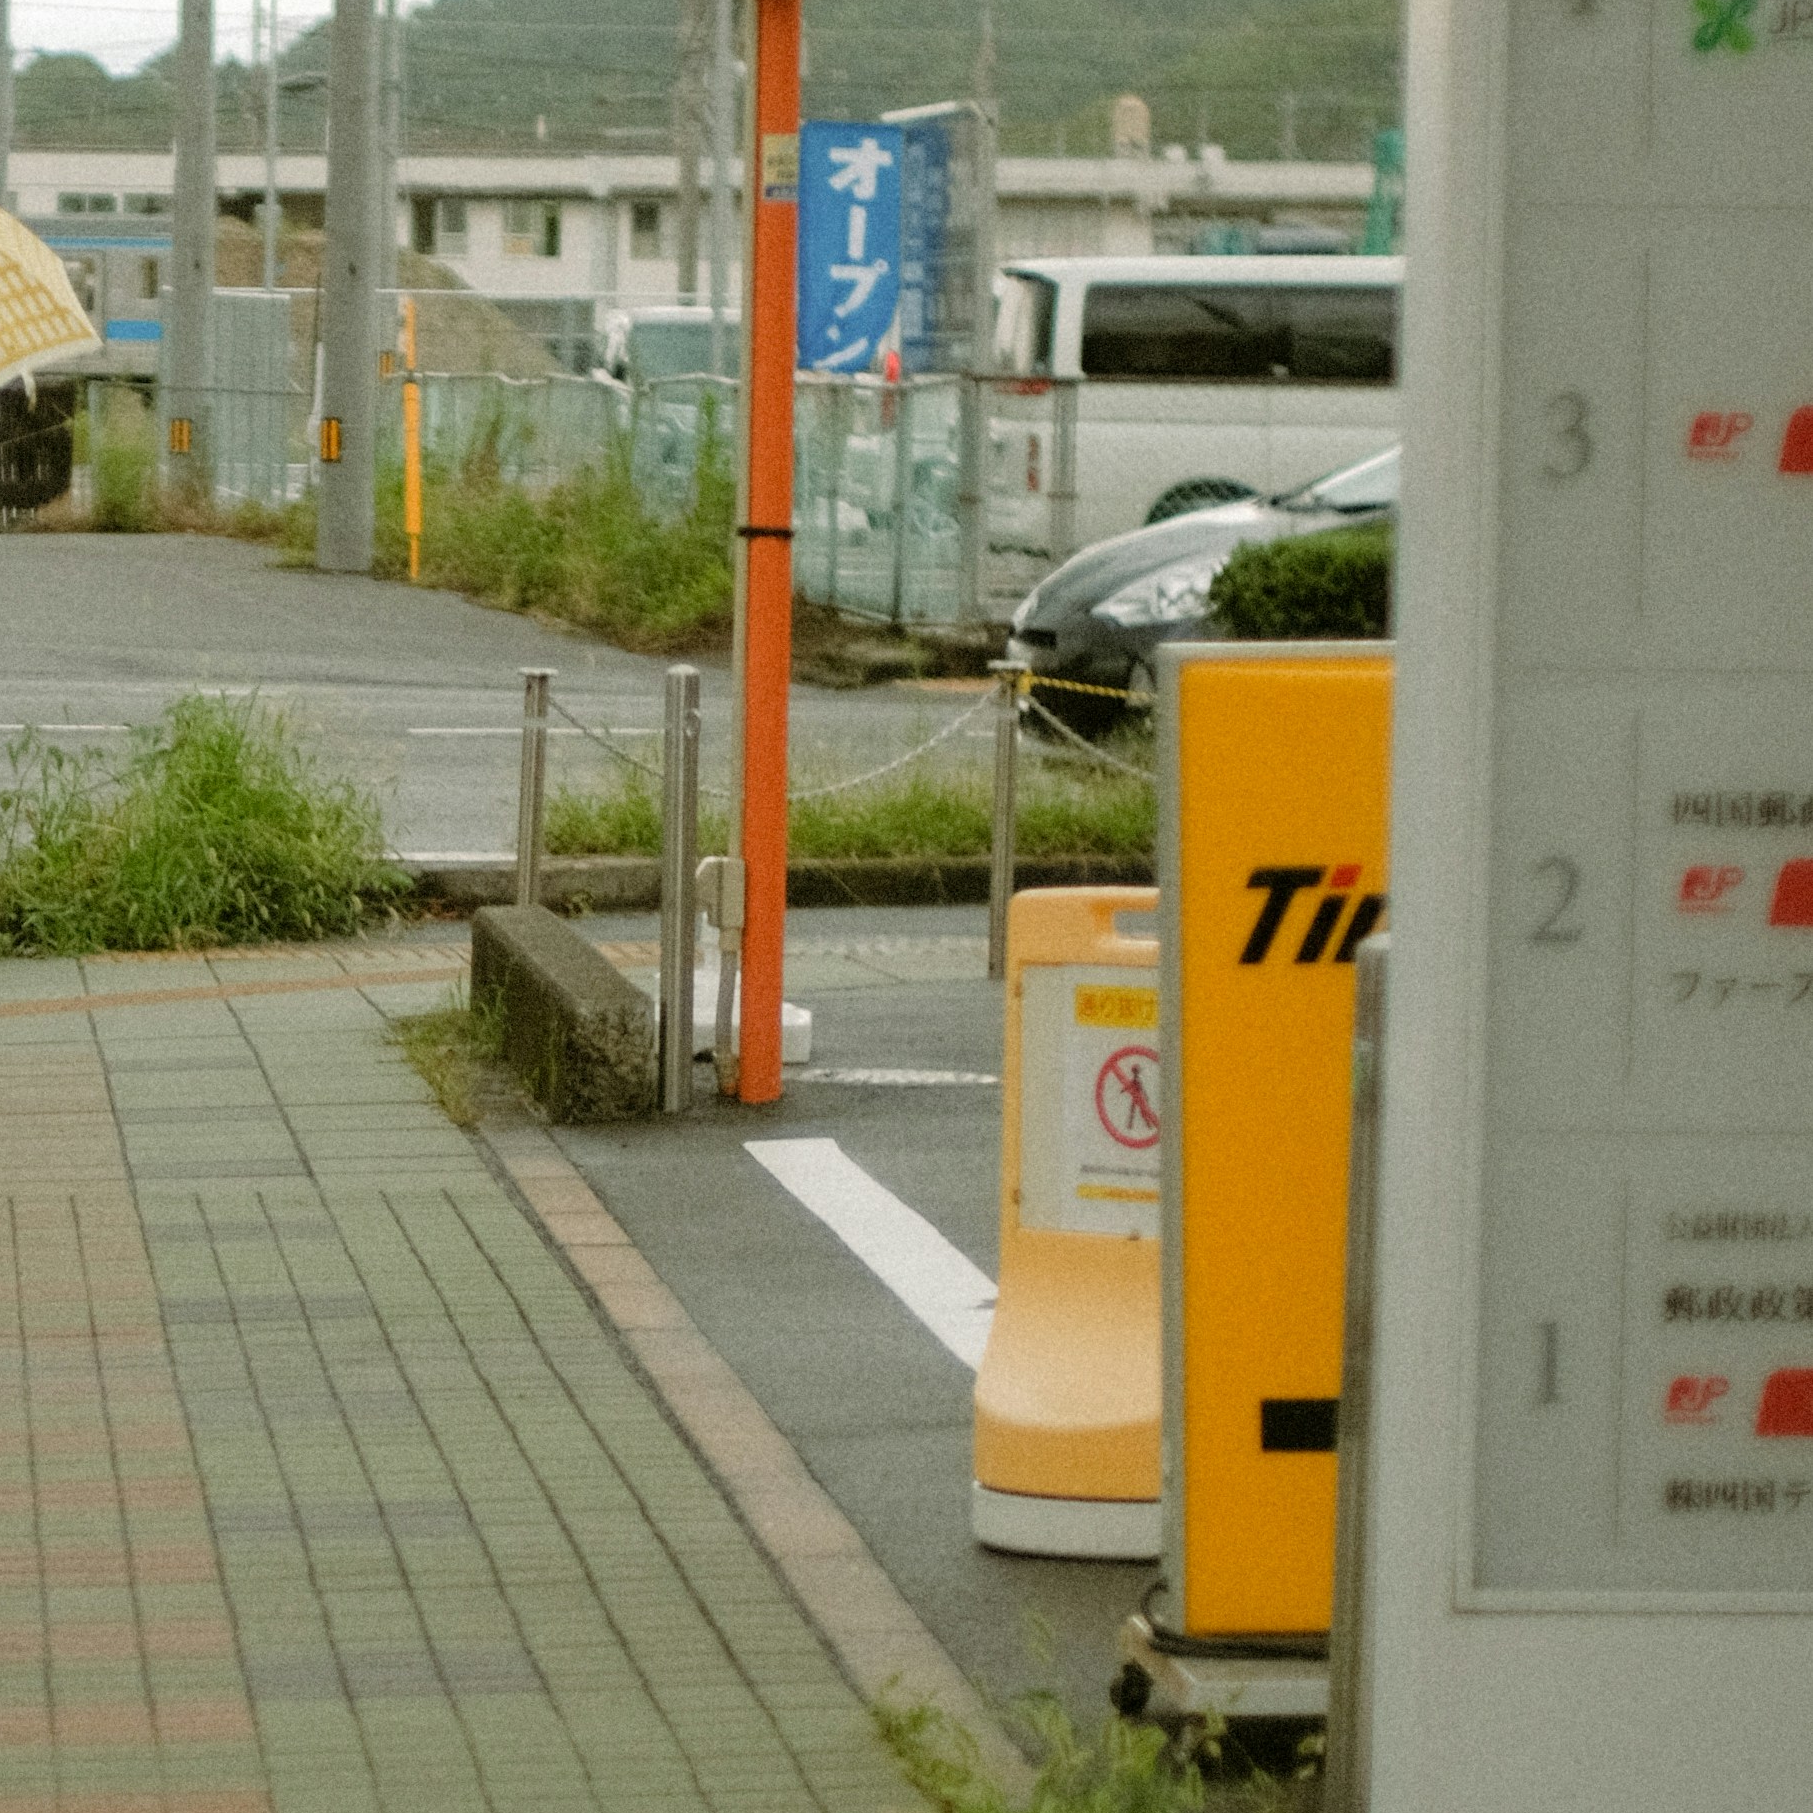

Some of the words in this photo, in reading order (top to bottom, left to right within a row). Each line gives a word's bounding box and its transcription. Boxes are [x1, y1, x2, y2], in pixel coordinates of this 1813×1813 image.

[815, 137, 893, 370] オープン
[1543, 390, 1592, 482] 3
[1531, 856, 1584, 945] 2
